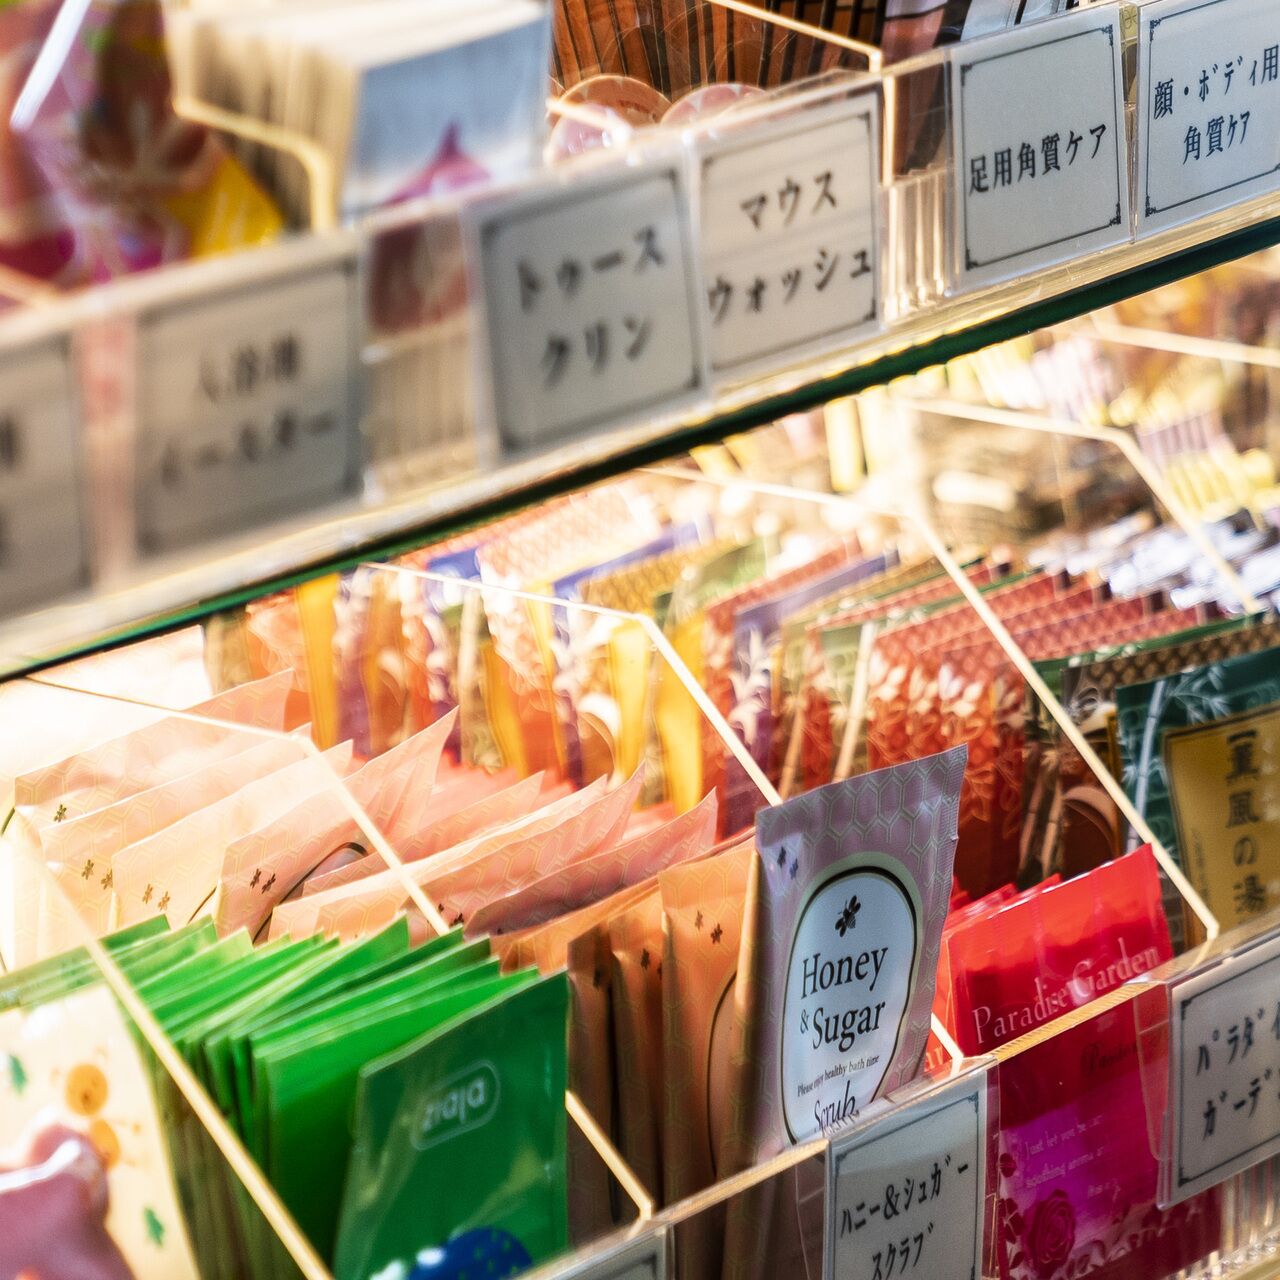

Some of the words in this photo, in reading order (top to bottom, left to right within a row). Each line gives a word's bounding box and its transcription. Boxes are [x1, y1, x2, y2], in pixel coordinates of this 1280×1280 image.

[1153, 43, 1280, 120] 顔・ボディ用
[968, 123, 1108, 196] 足用角質ケア
[1183, 110, 1252, 166] 角質ケア
[739, 169, 839, 231] マウス
[517, 223, 668, 314] トゥース
[706, 246, 873, 322] ウォッシュ
[540, 313, 655, 387] クリン
[800, 947, 888, 1000] Honey
[972, 977, 1068, 1045] Paradise
[1070, 937, 1160, 999] Garden
[800, 1008, 810, 1034] &
[812, 1001, 886, 1053] Sugar
[840, 1152, 969, 1239] ハニー&シュガー
[872, 1221, 934, 1280] スクラブ
